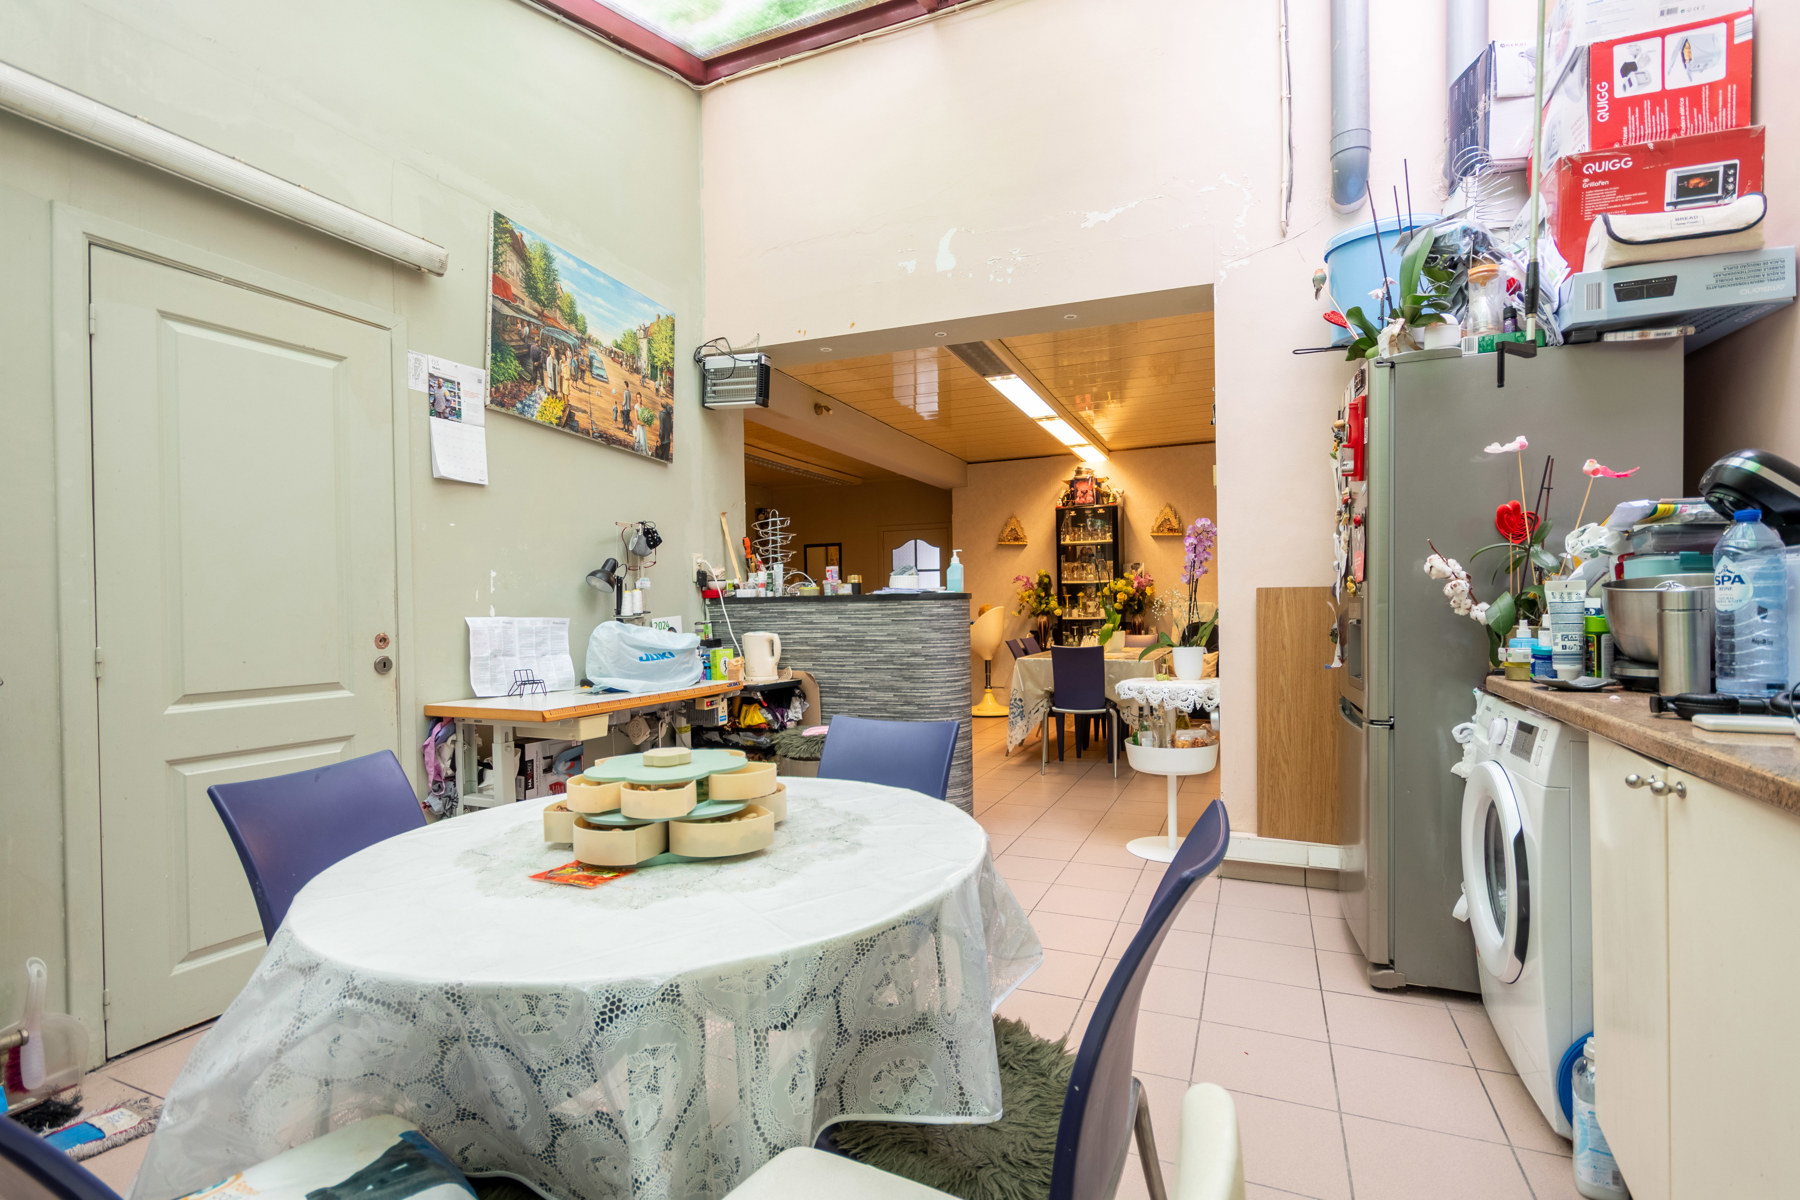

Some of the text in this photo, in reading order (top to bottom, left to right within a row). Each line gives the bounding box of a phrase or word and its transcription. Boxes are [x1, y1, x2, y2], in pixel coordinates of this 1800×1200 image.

[1596, 81, 1609, 122] QUIGG
[1583, 157, 1633, 175] QUIGG
[1582, 180, 1609, 188] Grillofen
[1715, 574, 1745, 586] SPA
[653, 620, 670, 630] 2024
[639, 651, 676, 662] JUKI
